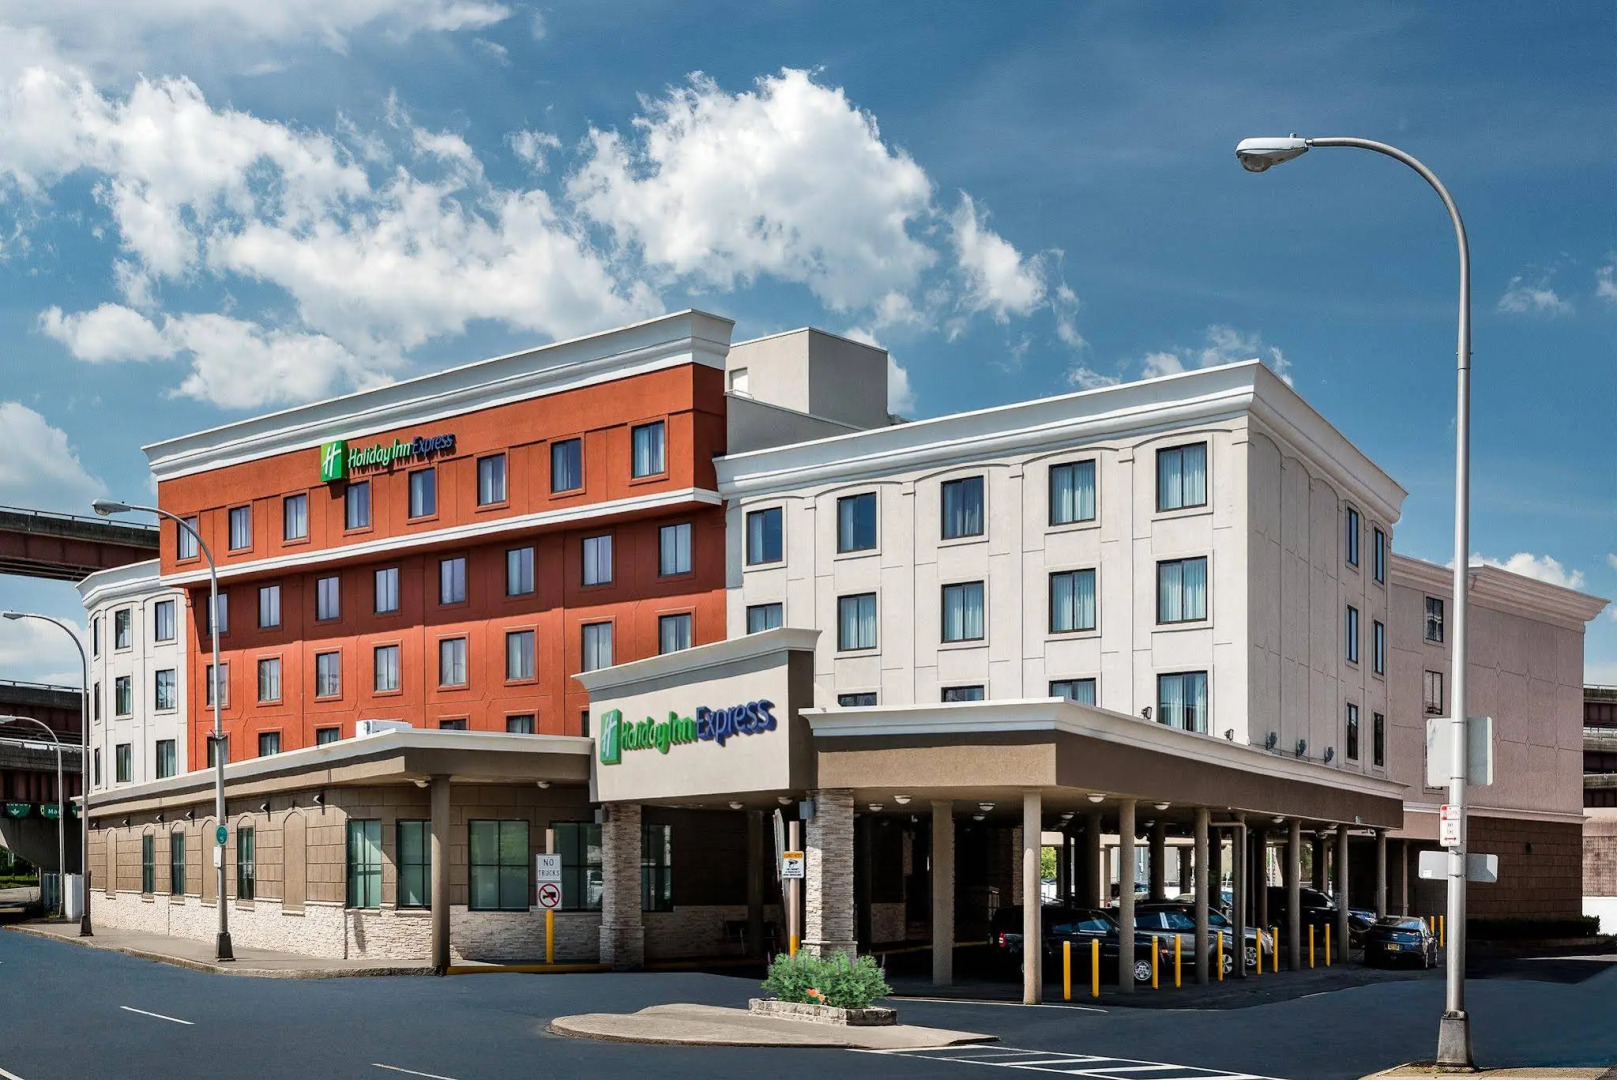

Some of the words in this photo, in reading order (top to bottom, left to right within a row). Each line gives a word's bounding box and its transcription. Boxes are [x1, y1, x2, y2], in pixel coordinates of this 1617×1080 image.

[348, 443, 391, 468] Holiday
[392, 438, 414, 459] Inn
[412, 434, 456, 456] Express
[621, 717, 669, 754] Holiday
[668, 711, 698, 745] Inn
[696, 699, 776, 747] Express
[543, 858, 555, 867] NO
